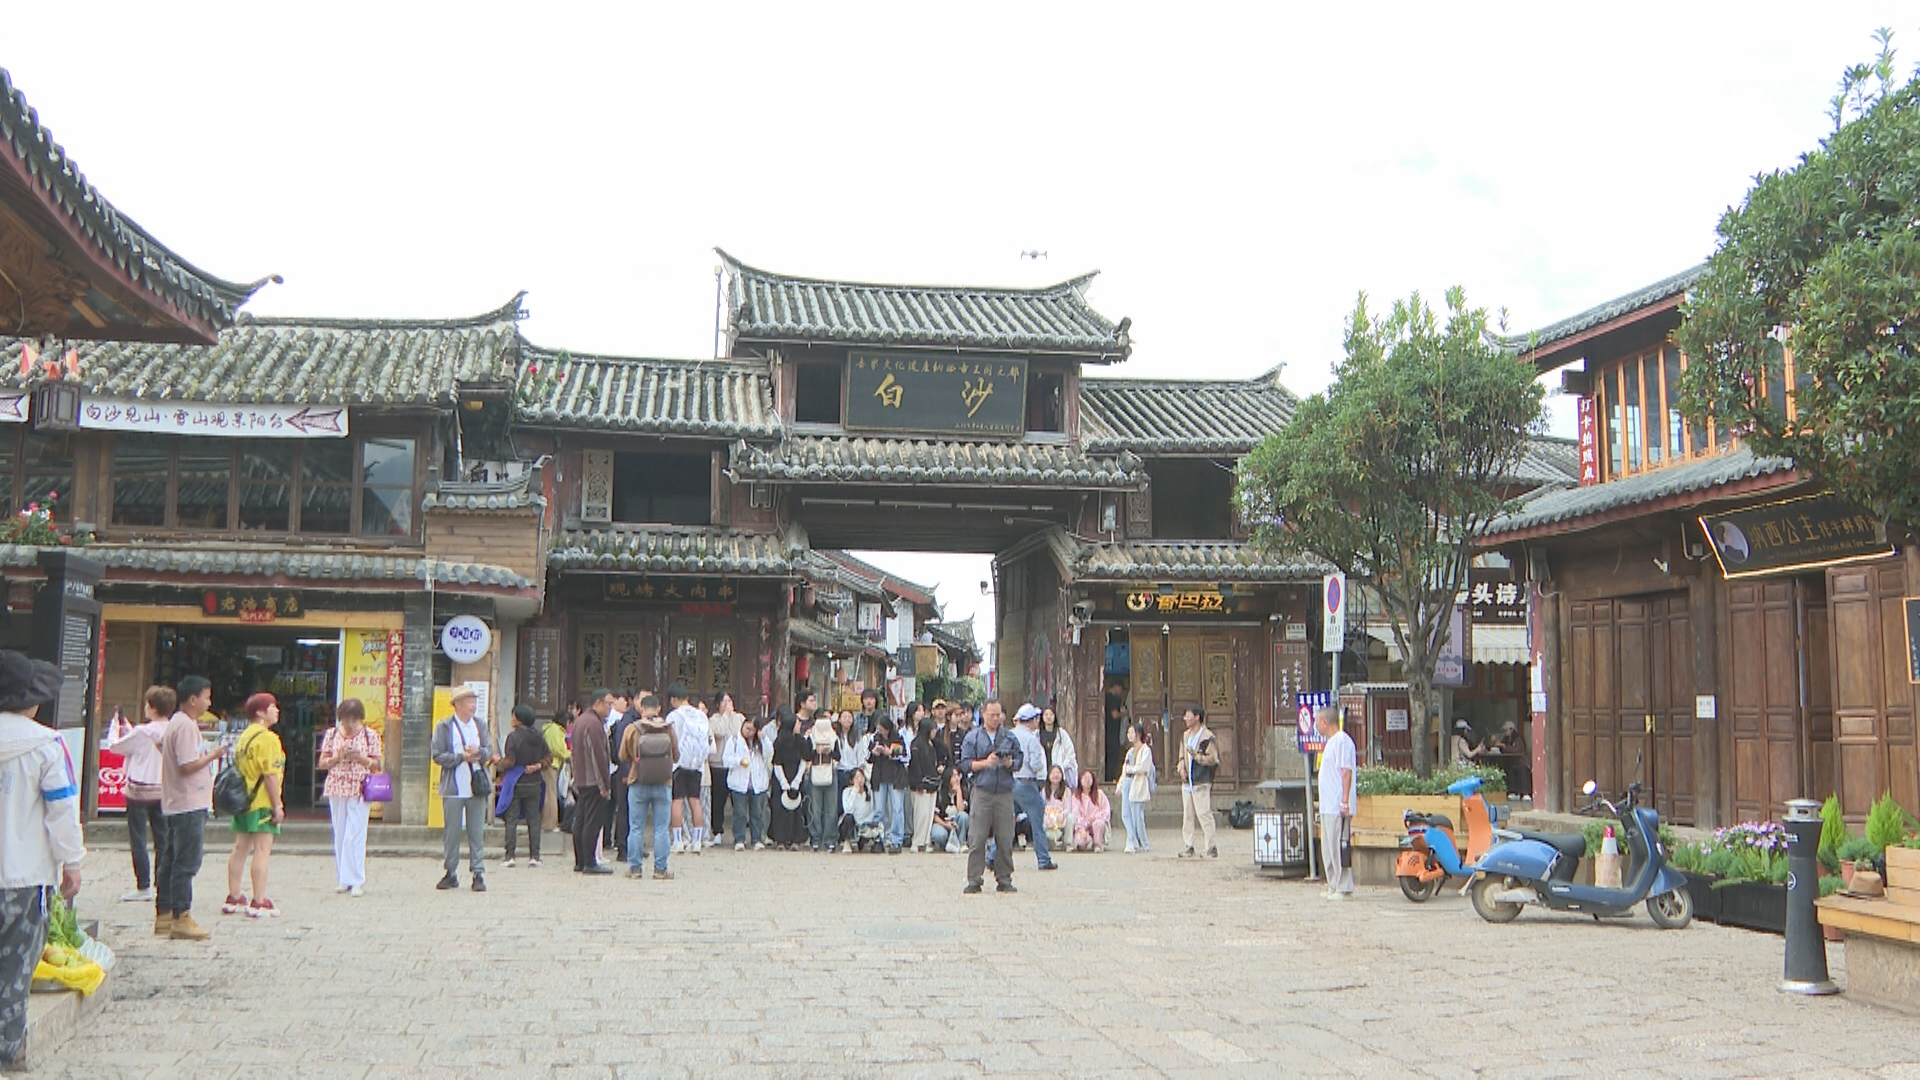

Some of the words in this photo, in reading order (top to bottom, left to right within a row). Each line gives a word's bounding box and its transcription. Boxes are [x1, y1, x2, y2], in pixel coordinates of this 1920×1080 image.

[873, 373, 994, 418] 白沙
[1580, 398, 1595, 481] 打卡拍照点
